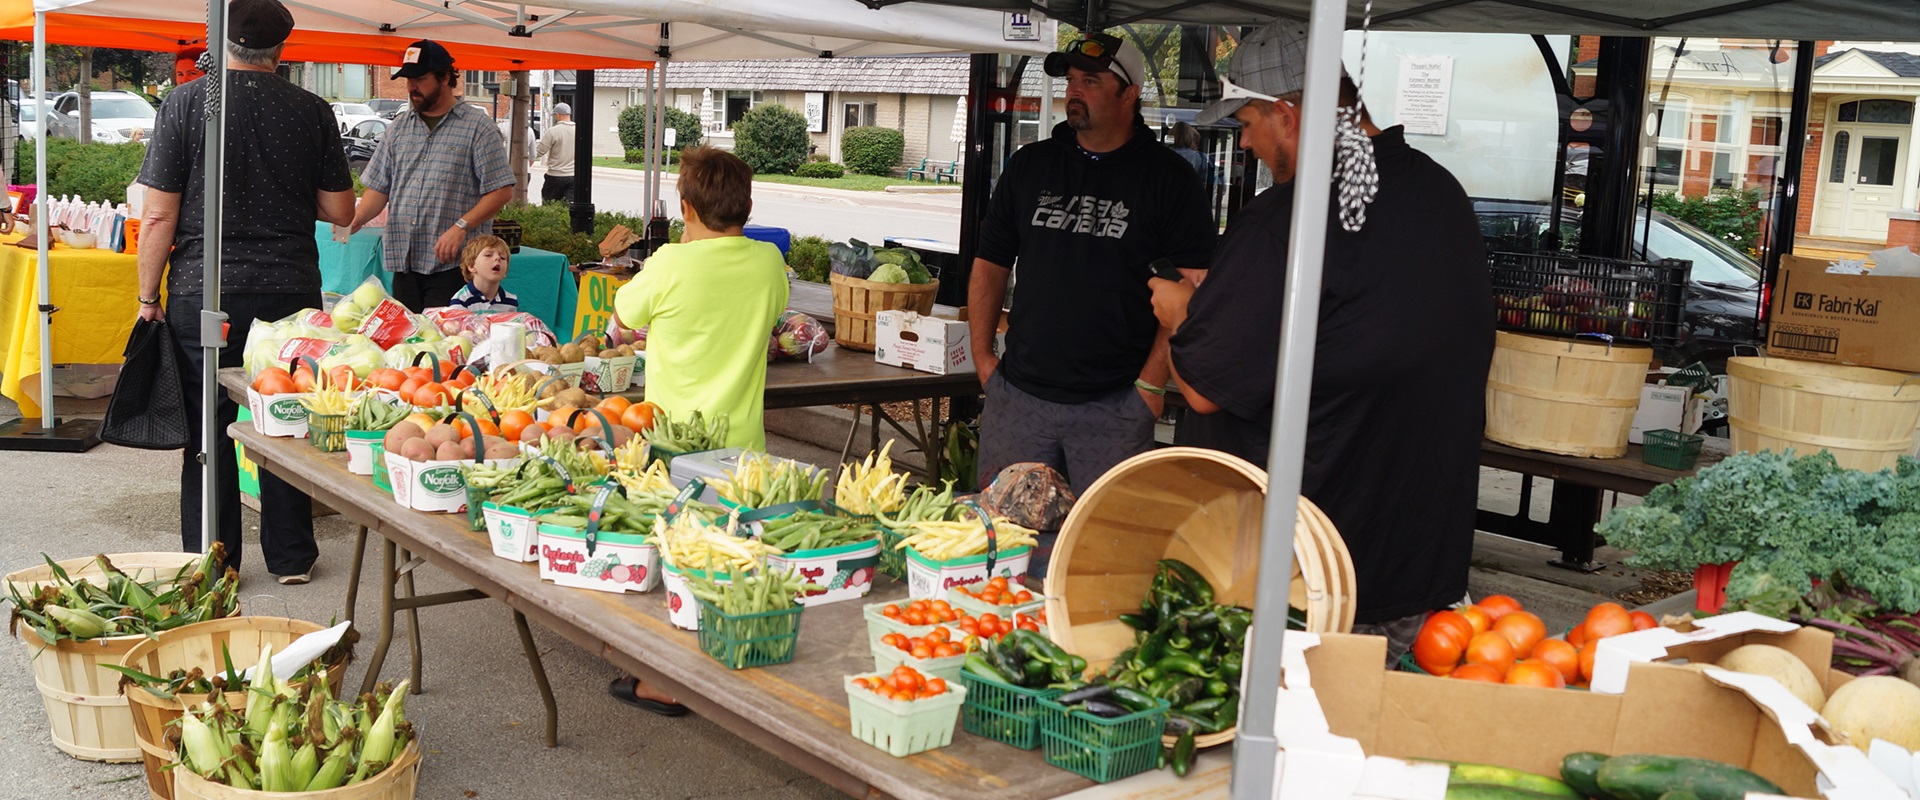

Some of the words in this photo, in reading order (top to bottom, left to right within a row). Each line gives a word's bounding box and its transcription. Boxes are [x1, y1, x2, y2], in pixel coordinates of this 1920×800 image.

[1776, 324, 1809, 334] 9502055
[952, 355, 966, 367] FARM
[274, 403, 304, 420] Norfolk
[424, 473, 459, 492] Norfolk
[543, 545, 585, 563] Ontario
[549, 559, 577, 574] Fruit
